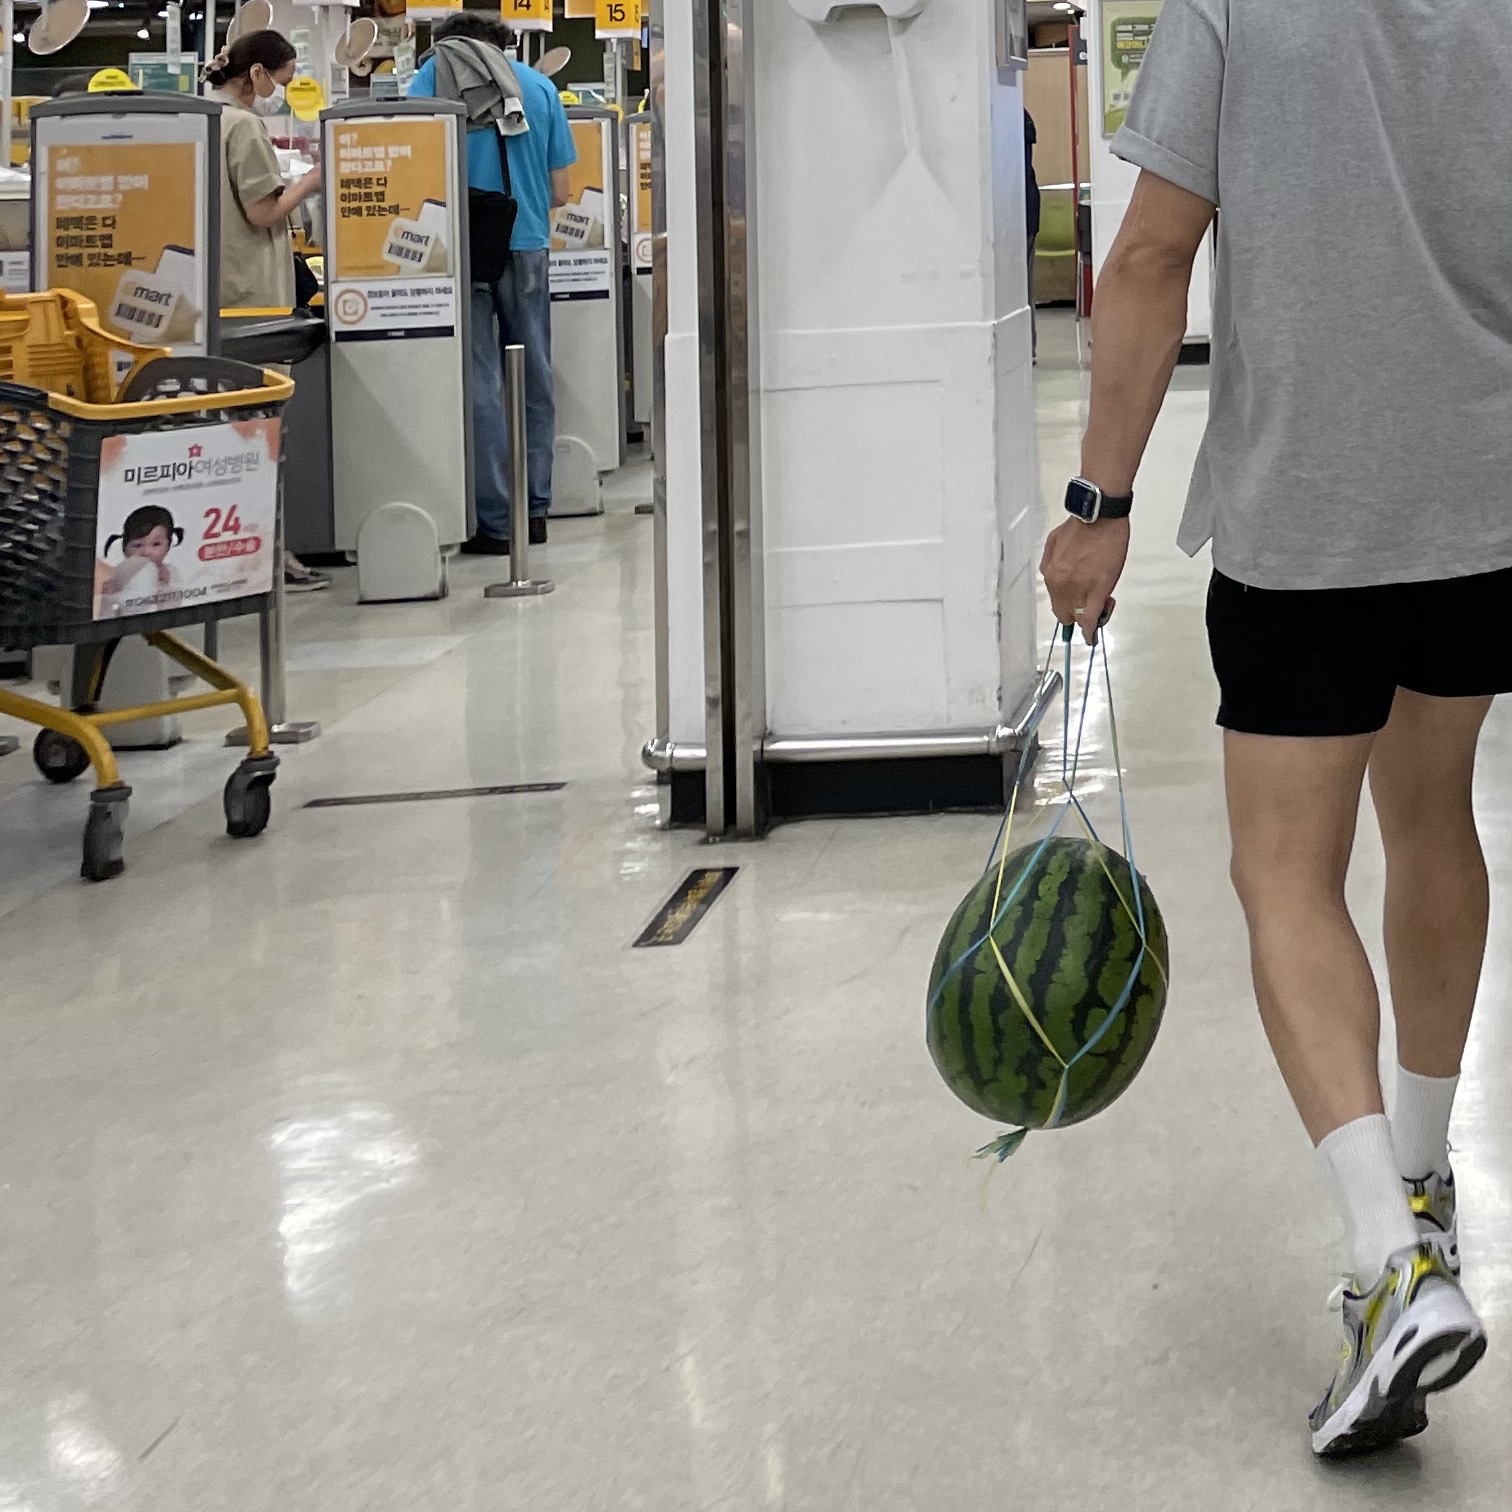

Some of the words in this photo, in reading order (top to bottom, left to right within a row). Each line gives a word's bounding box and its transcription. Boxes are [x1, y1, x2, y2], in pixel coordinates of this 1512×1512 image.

[606, 4, 626, 23] 15
[376, 176, 388, 189] 다
[203, 504, 242, 541] 24
